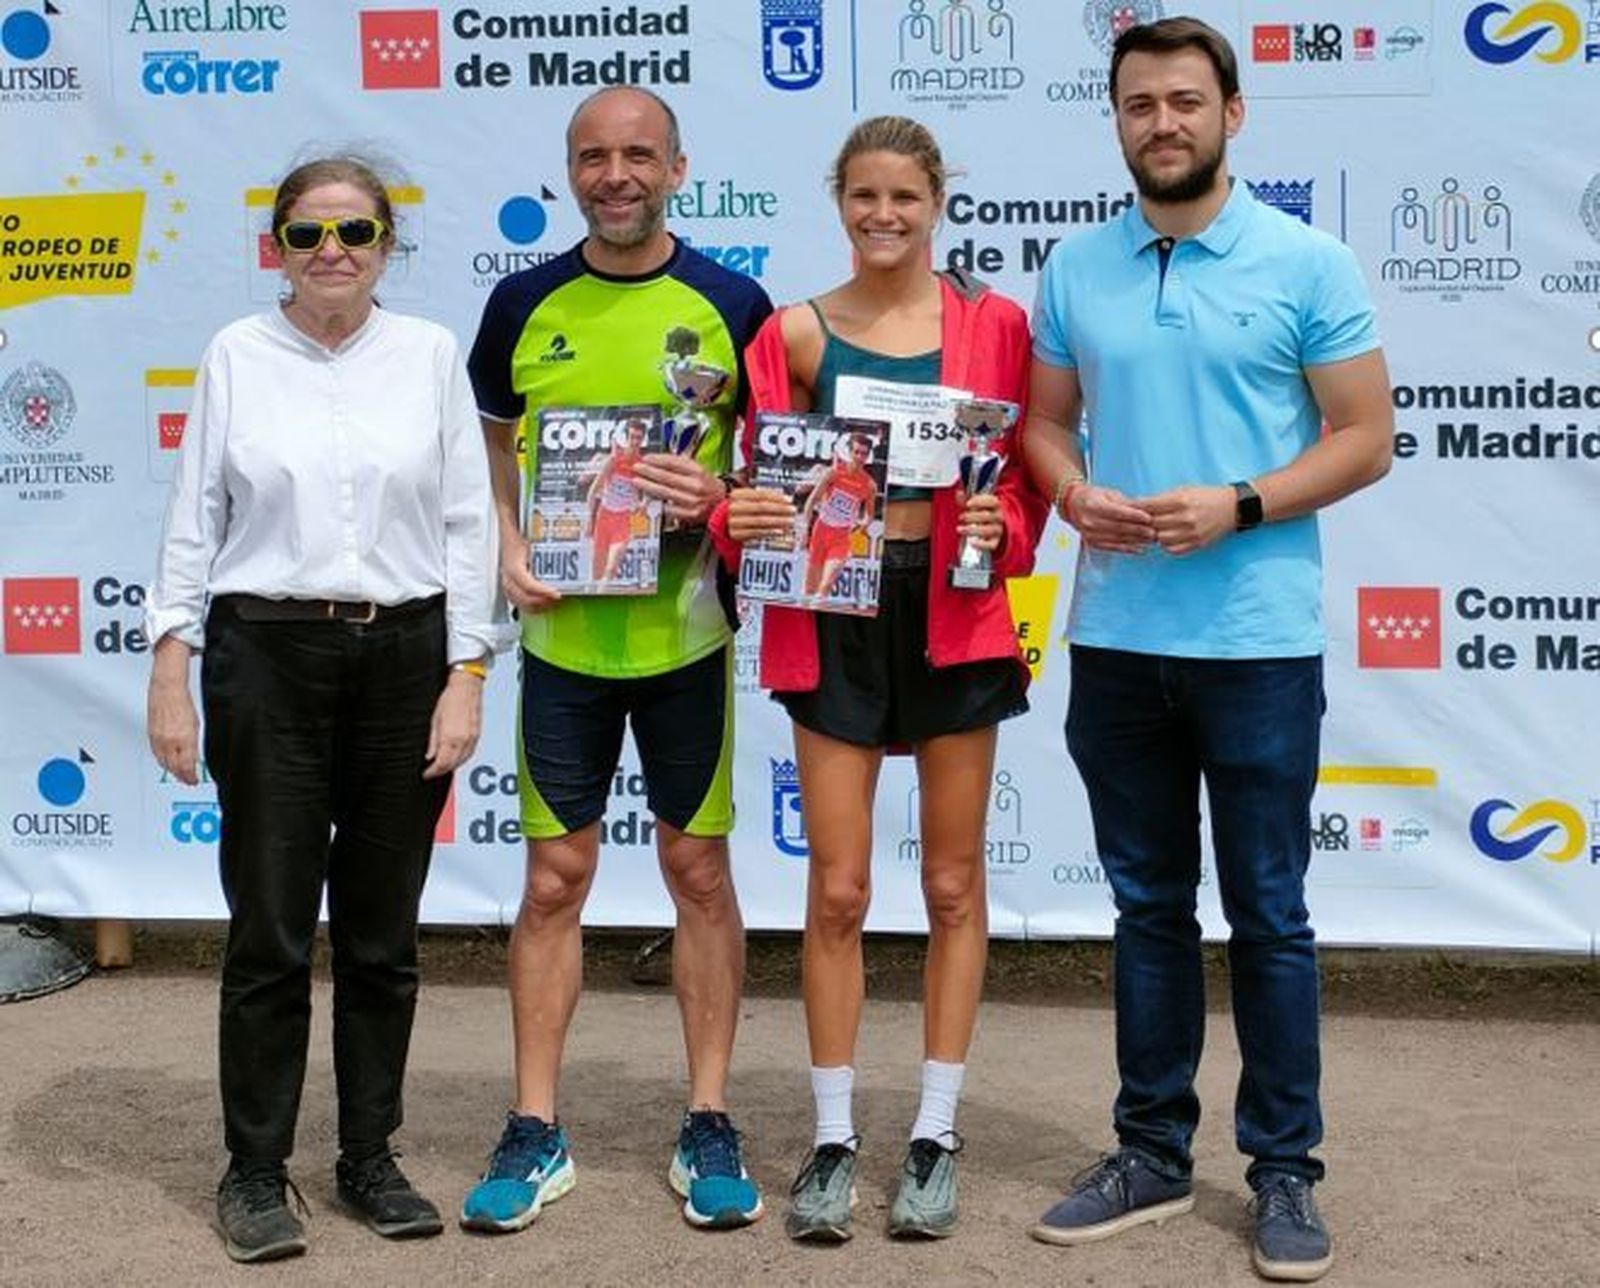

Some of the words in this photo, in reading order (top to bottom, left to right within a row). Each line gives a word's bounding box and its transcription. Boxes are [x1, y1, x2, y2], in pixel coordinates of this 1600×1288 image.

[130, 0, 288, 32] AireLibre
[453, 5, 689, 39] Comunidad
[142, 59, 280, 95] correr
[455, 54, 512, 88] de
[529, 50, 690, 86] Madrid
[891, 67, 1025, 91] MADRID
[89, 237, 120, 255] DE
[947, 239, 1005, 273] de
[9, 262, 132, 281] JUVENTUD
[1382, 258, 1522, 281] MADRID
[906, 421, 965, 442] 1534
[94, 621, 149, 653] de
[1456, 634, 1517, 670] de
[13, 813, 112, 836] OUTSIDE
